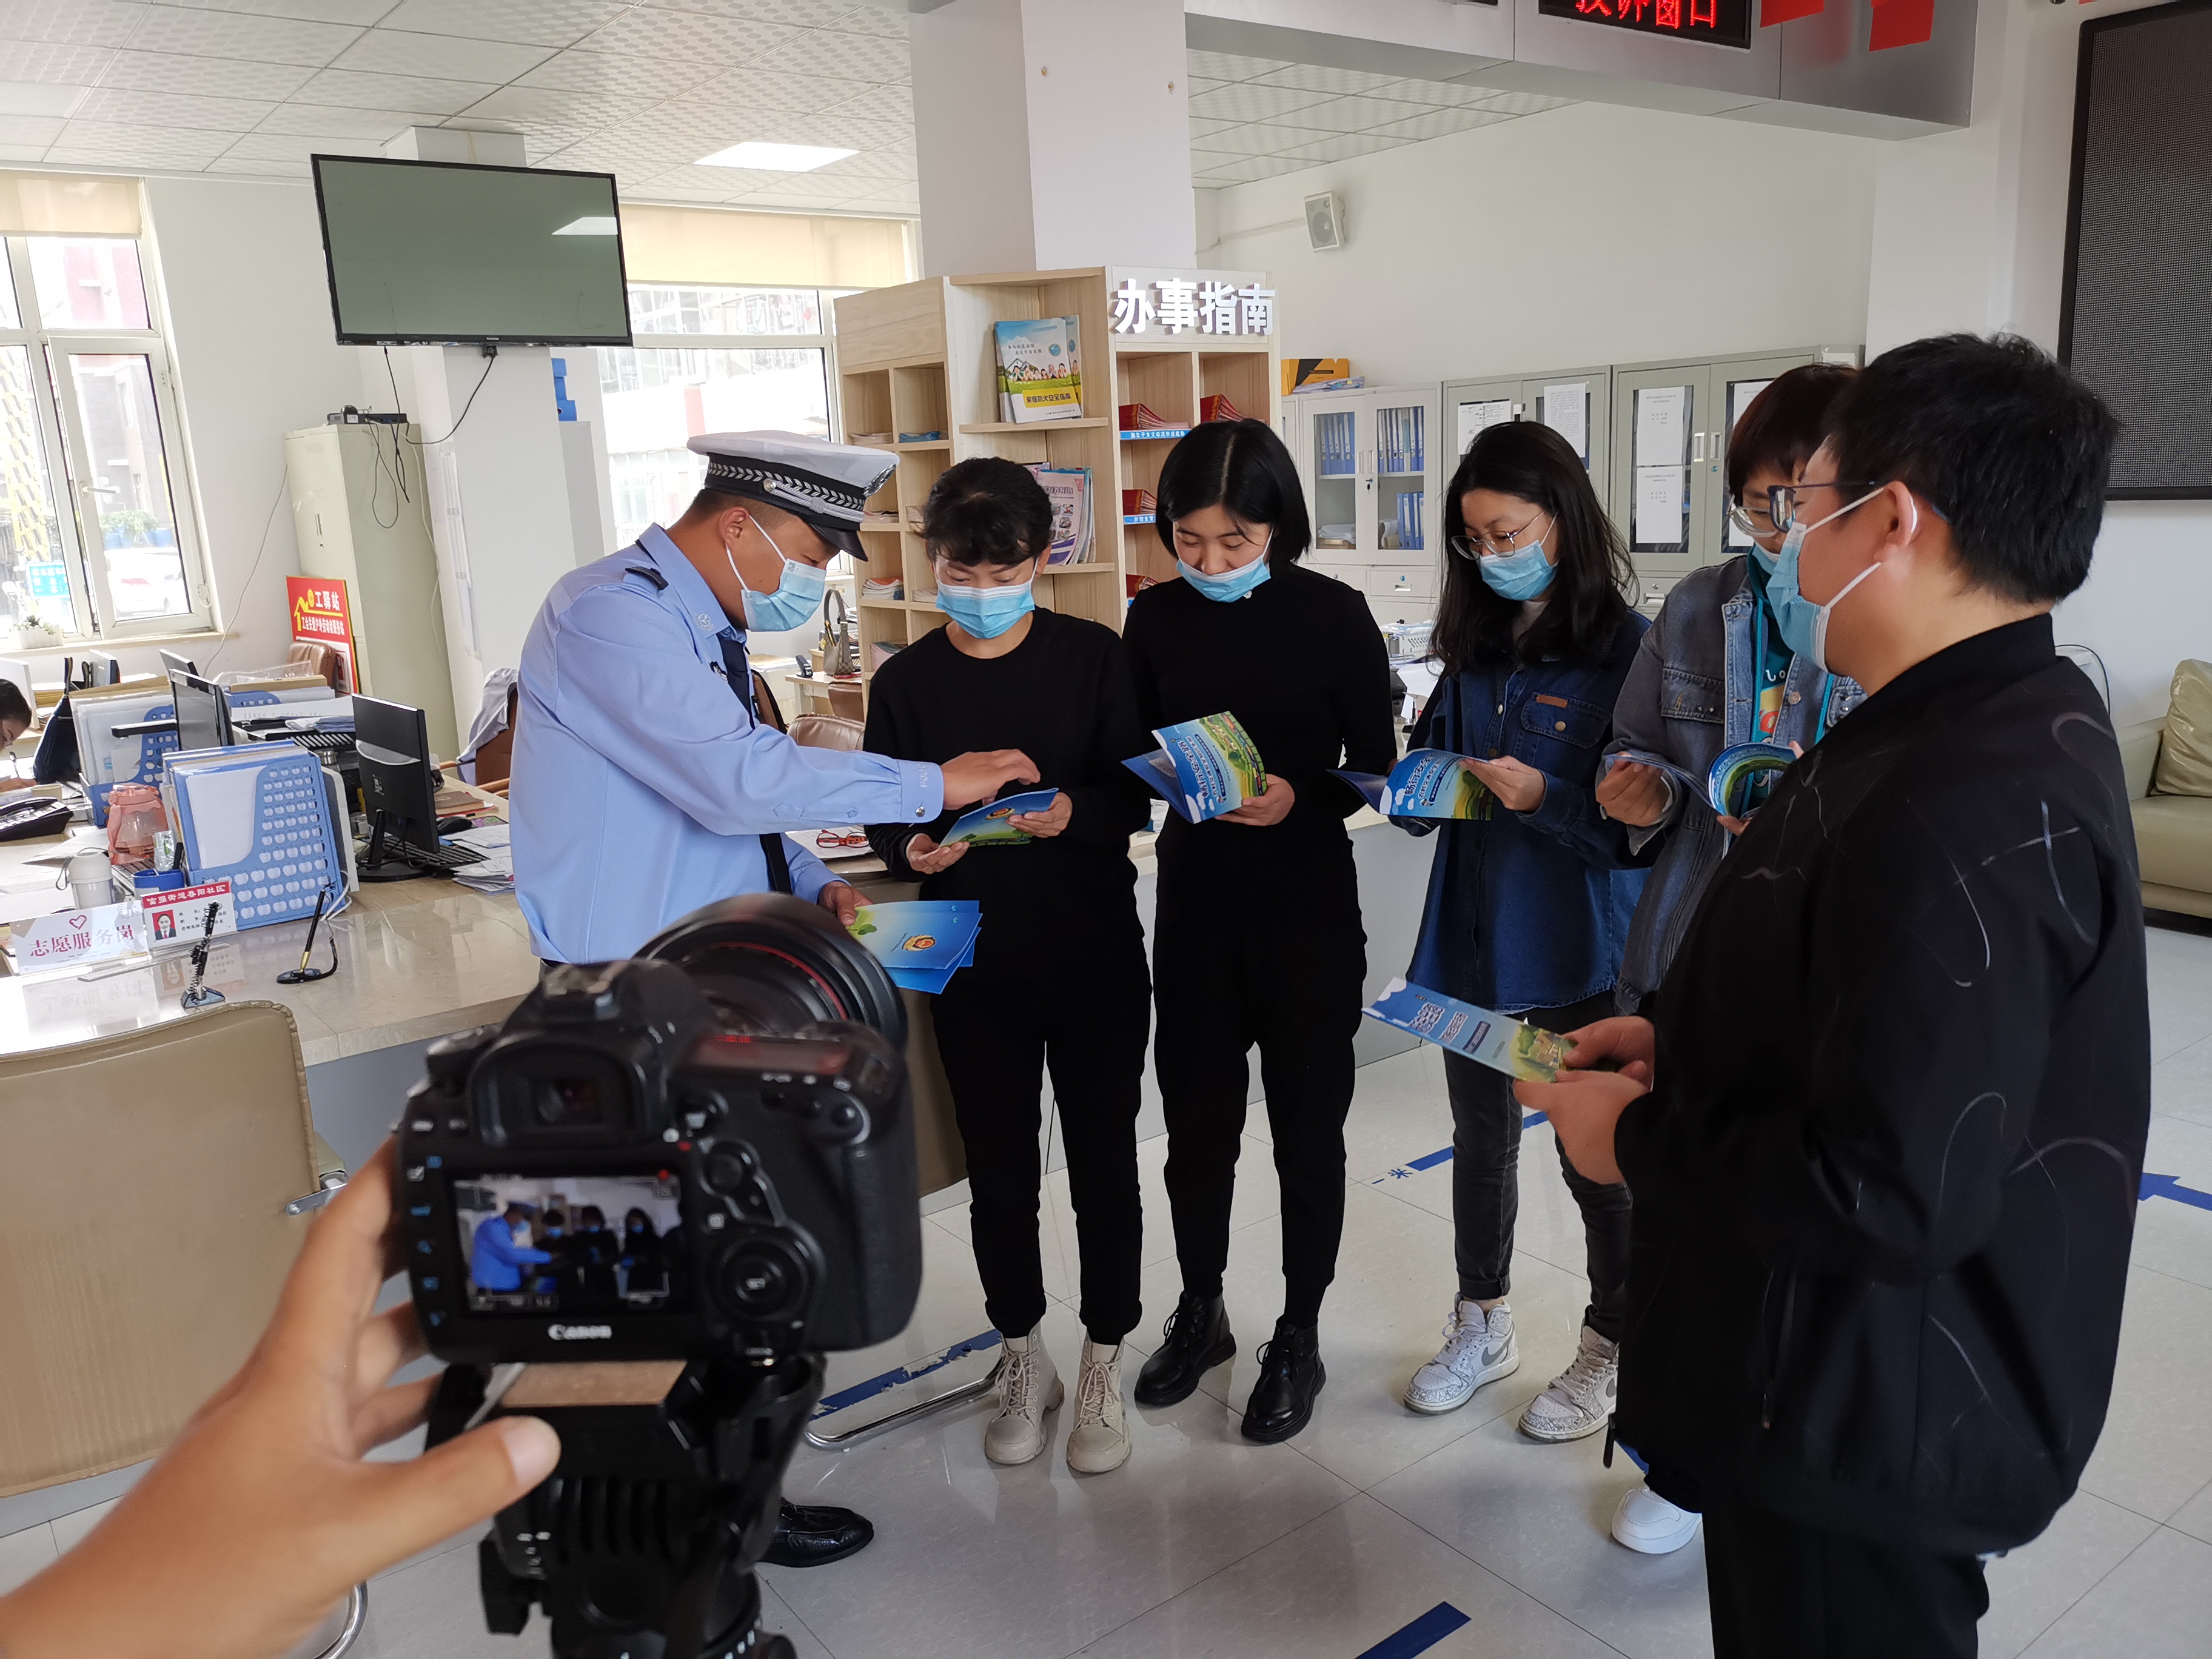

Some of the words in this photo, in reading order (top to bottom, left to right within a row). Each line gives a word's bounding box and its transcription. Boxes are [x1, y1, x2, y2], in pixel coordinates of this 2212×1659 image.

[1114, 278, 1275, 336] 办事指南
[1026, 392, 1071, 403] 家庭防火安全指南
[315, 590, 340, 611] 工驿站
[1178, 740, 1210, 798] 畅行安全路
[1404, 753, 1436, 796] 畅行安全
[146, 883, 226, 906] 富强街道春阳社区
[30, 924, 133, 957] 志愿服务岗
[548, 1324, 612, 1341] Canon
